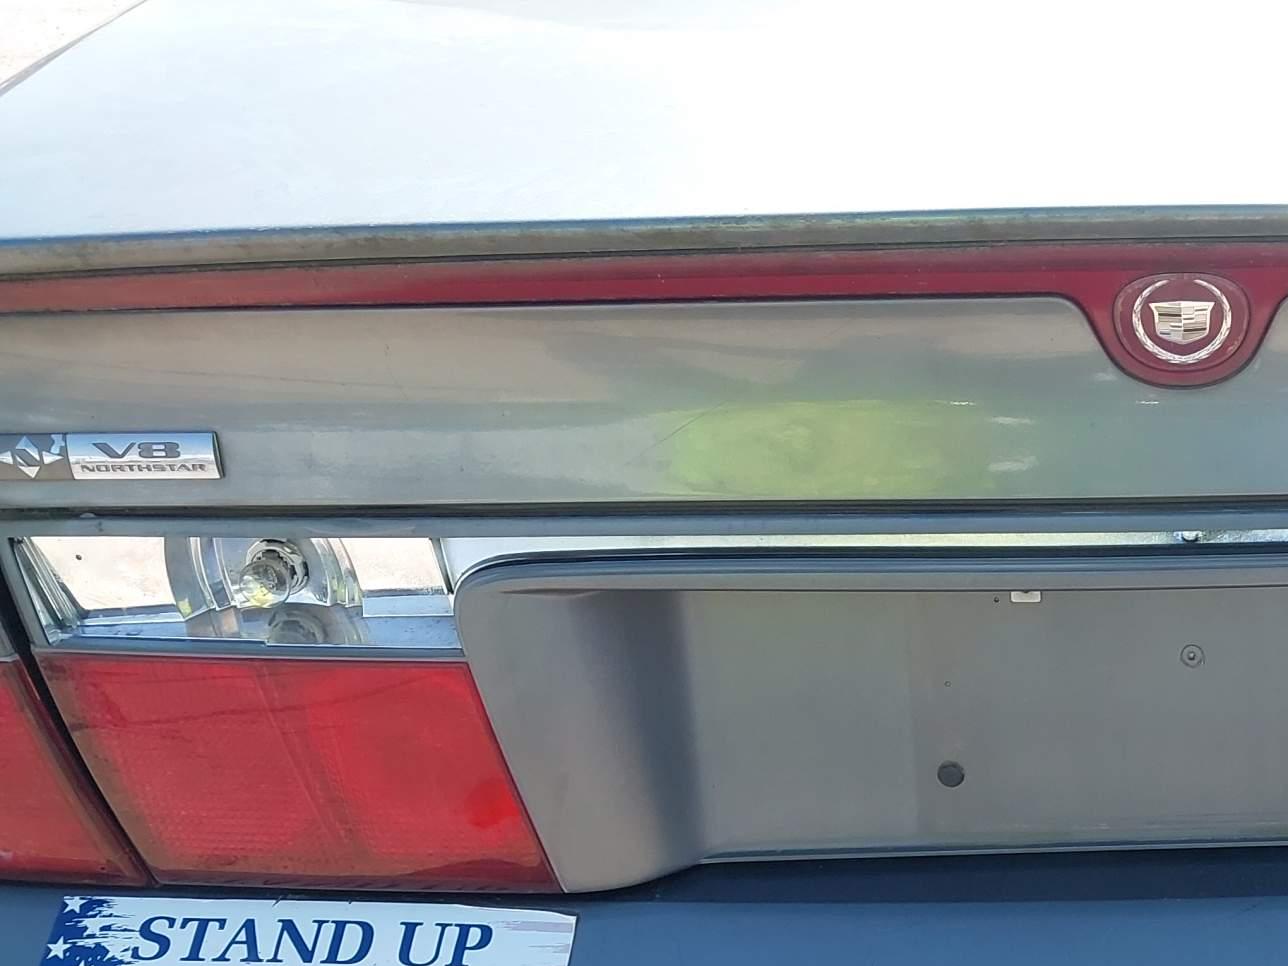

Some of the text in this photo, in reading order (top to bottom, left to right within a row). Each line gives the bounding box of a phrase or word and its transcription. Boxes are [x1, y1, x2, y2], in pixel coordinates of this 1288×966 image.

[92, 441, 181, 459] V8
[80, 463, 207, 473] NORTHSTAR
[131, 915, 374, 966] STAND
